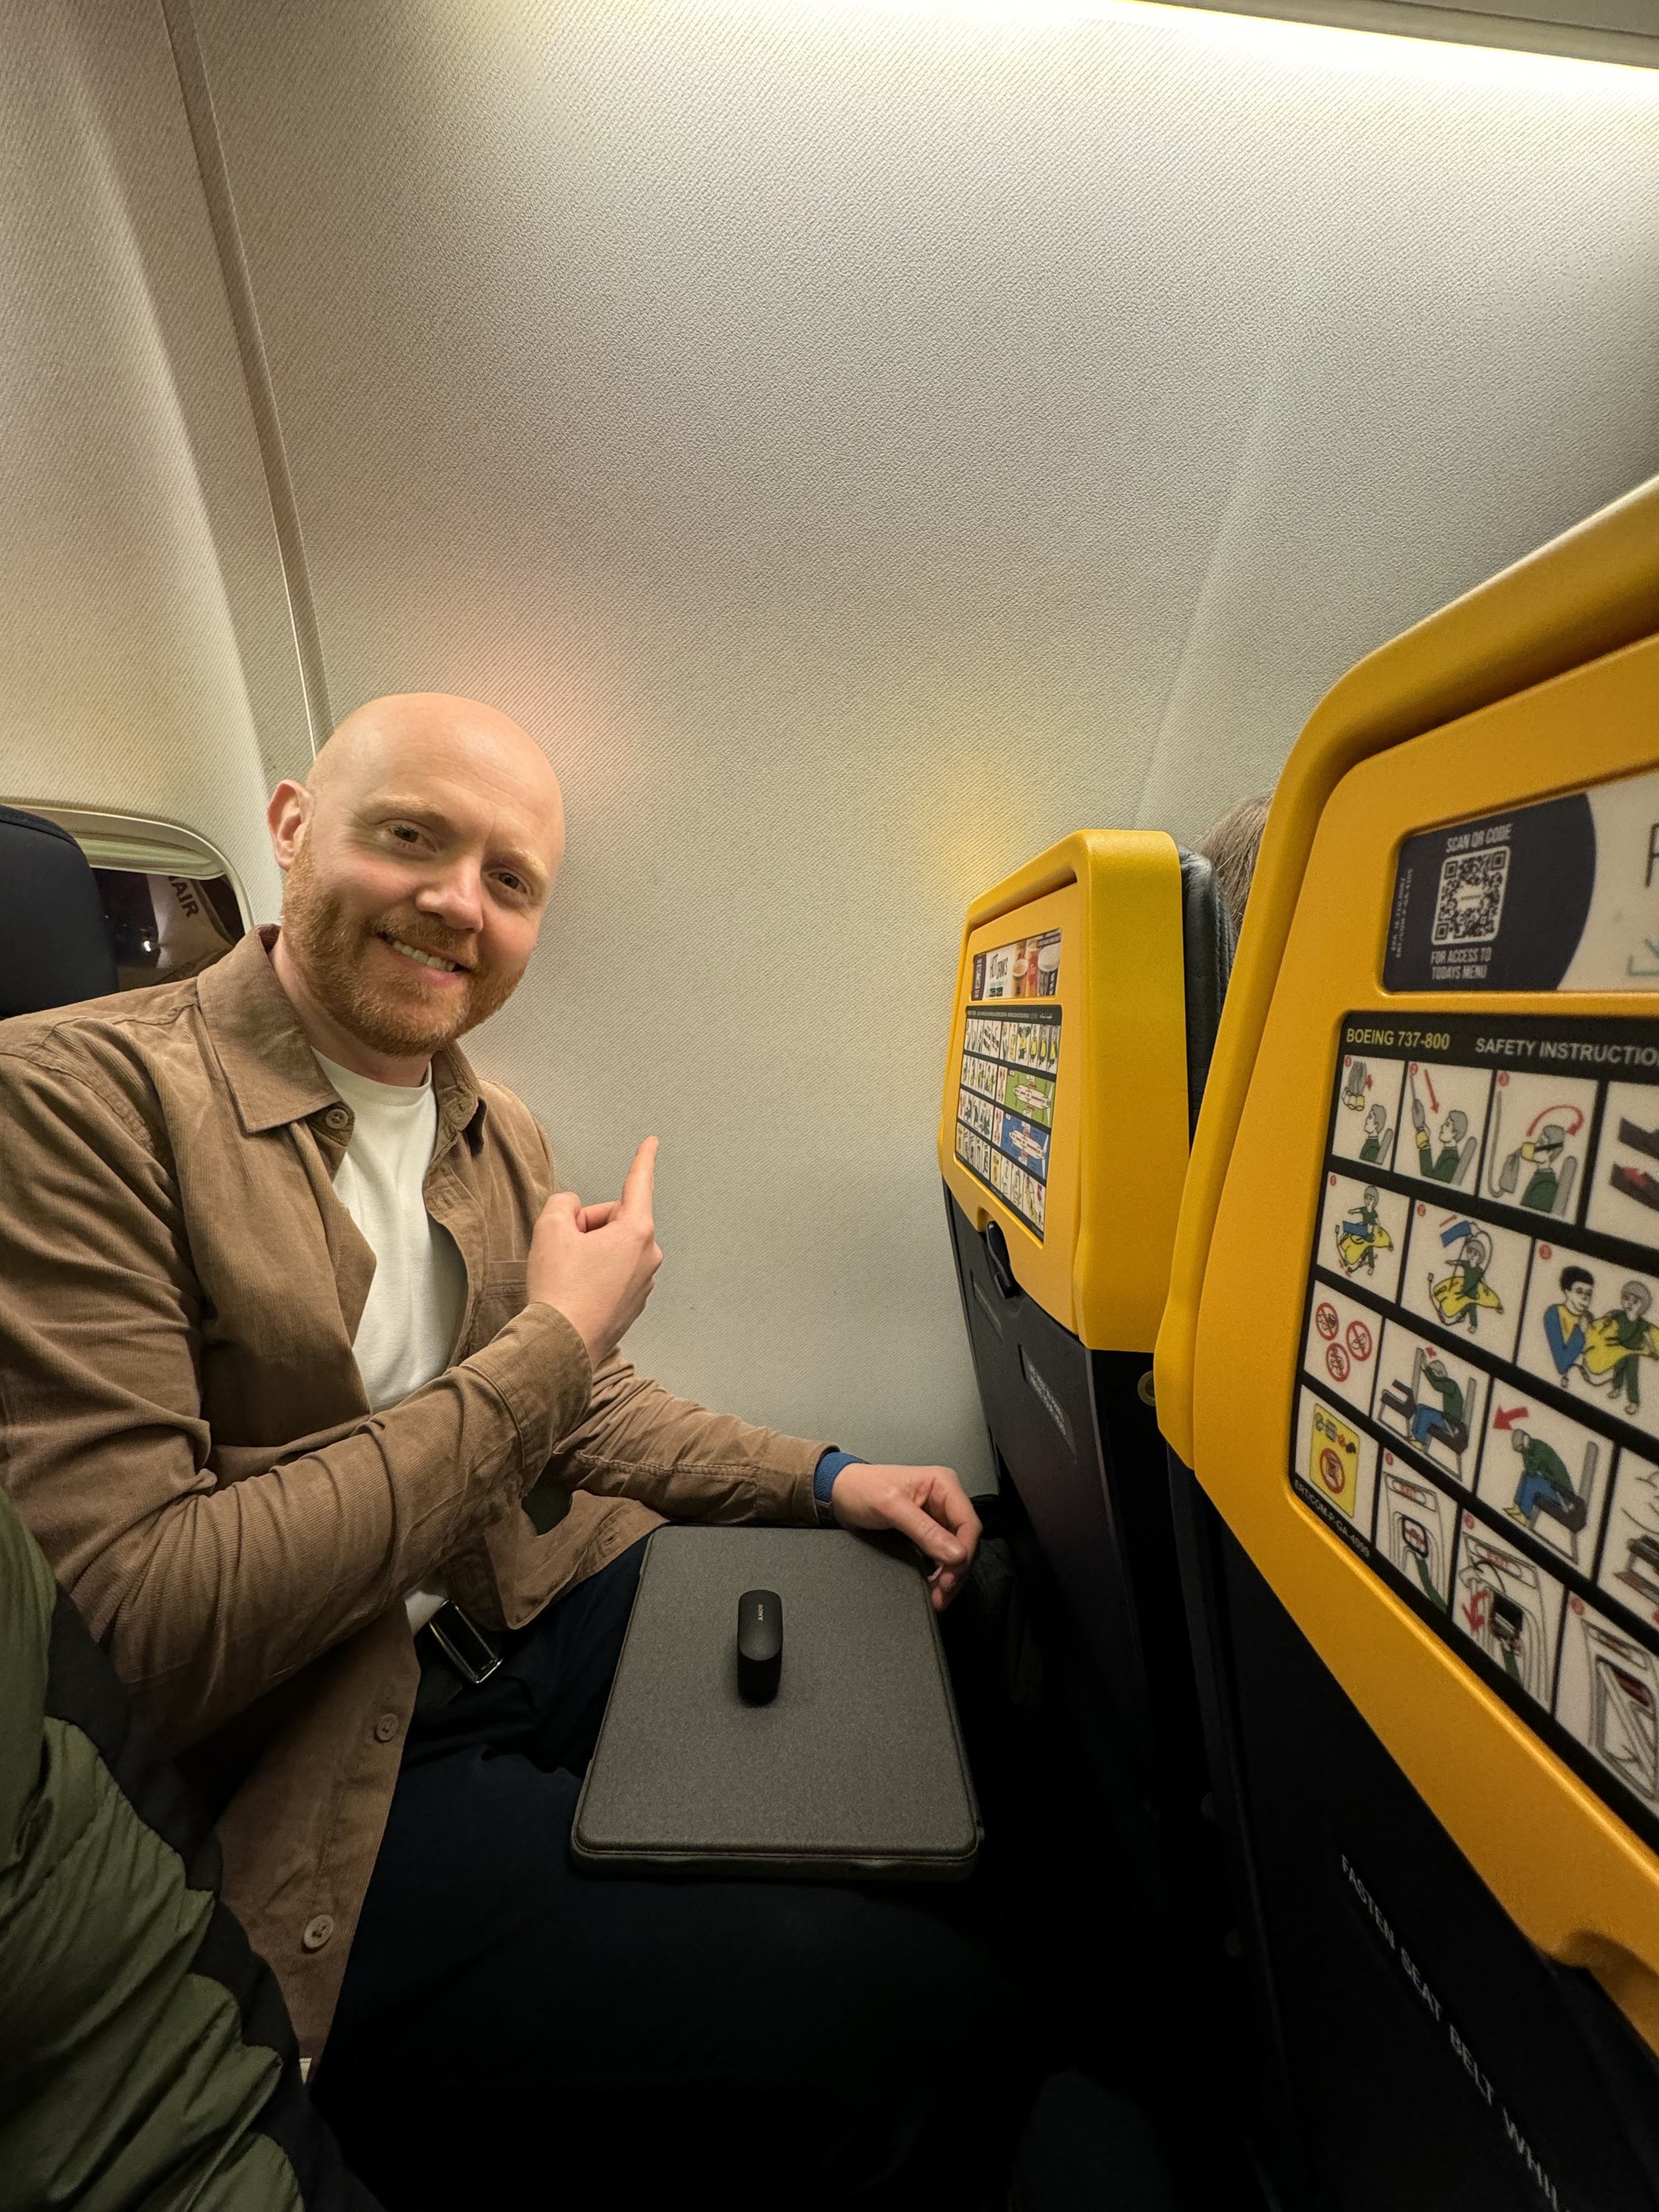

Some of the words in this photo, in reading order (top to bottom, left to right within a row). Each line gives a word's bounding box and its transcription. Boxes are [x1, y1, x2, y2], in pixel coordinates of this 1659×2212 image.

[1446, 834, 1471, 853] SCAN
[1486, 823, 1513, 843] CODE
[168, 876, 199, 918] AIR
[1431, 950, 1447, 965] FOR
[1447, 948, 1479, 963] ACCESS
[1481, 947, 1492, 962] TO
[1462, 964, 1488, 980] MENU
[1346, 1028, 1394, 1046] BOEING
[1398, 1031, 1450, 1050] 737-800
[1475, 1037, 1535, 1057] SAFETY
[1539, 1040, 1659, 1067] INSTRUCTIO
[1341, 1853, 1396, 1950] FASTEN
[1401, 1947, 1443, 2022] SEAT
[1449, 2024, 1494, 2107] BELT
